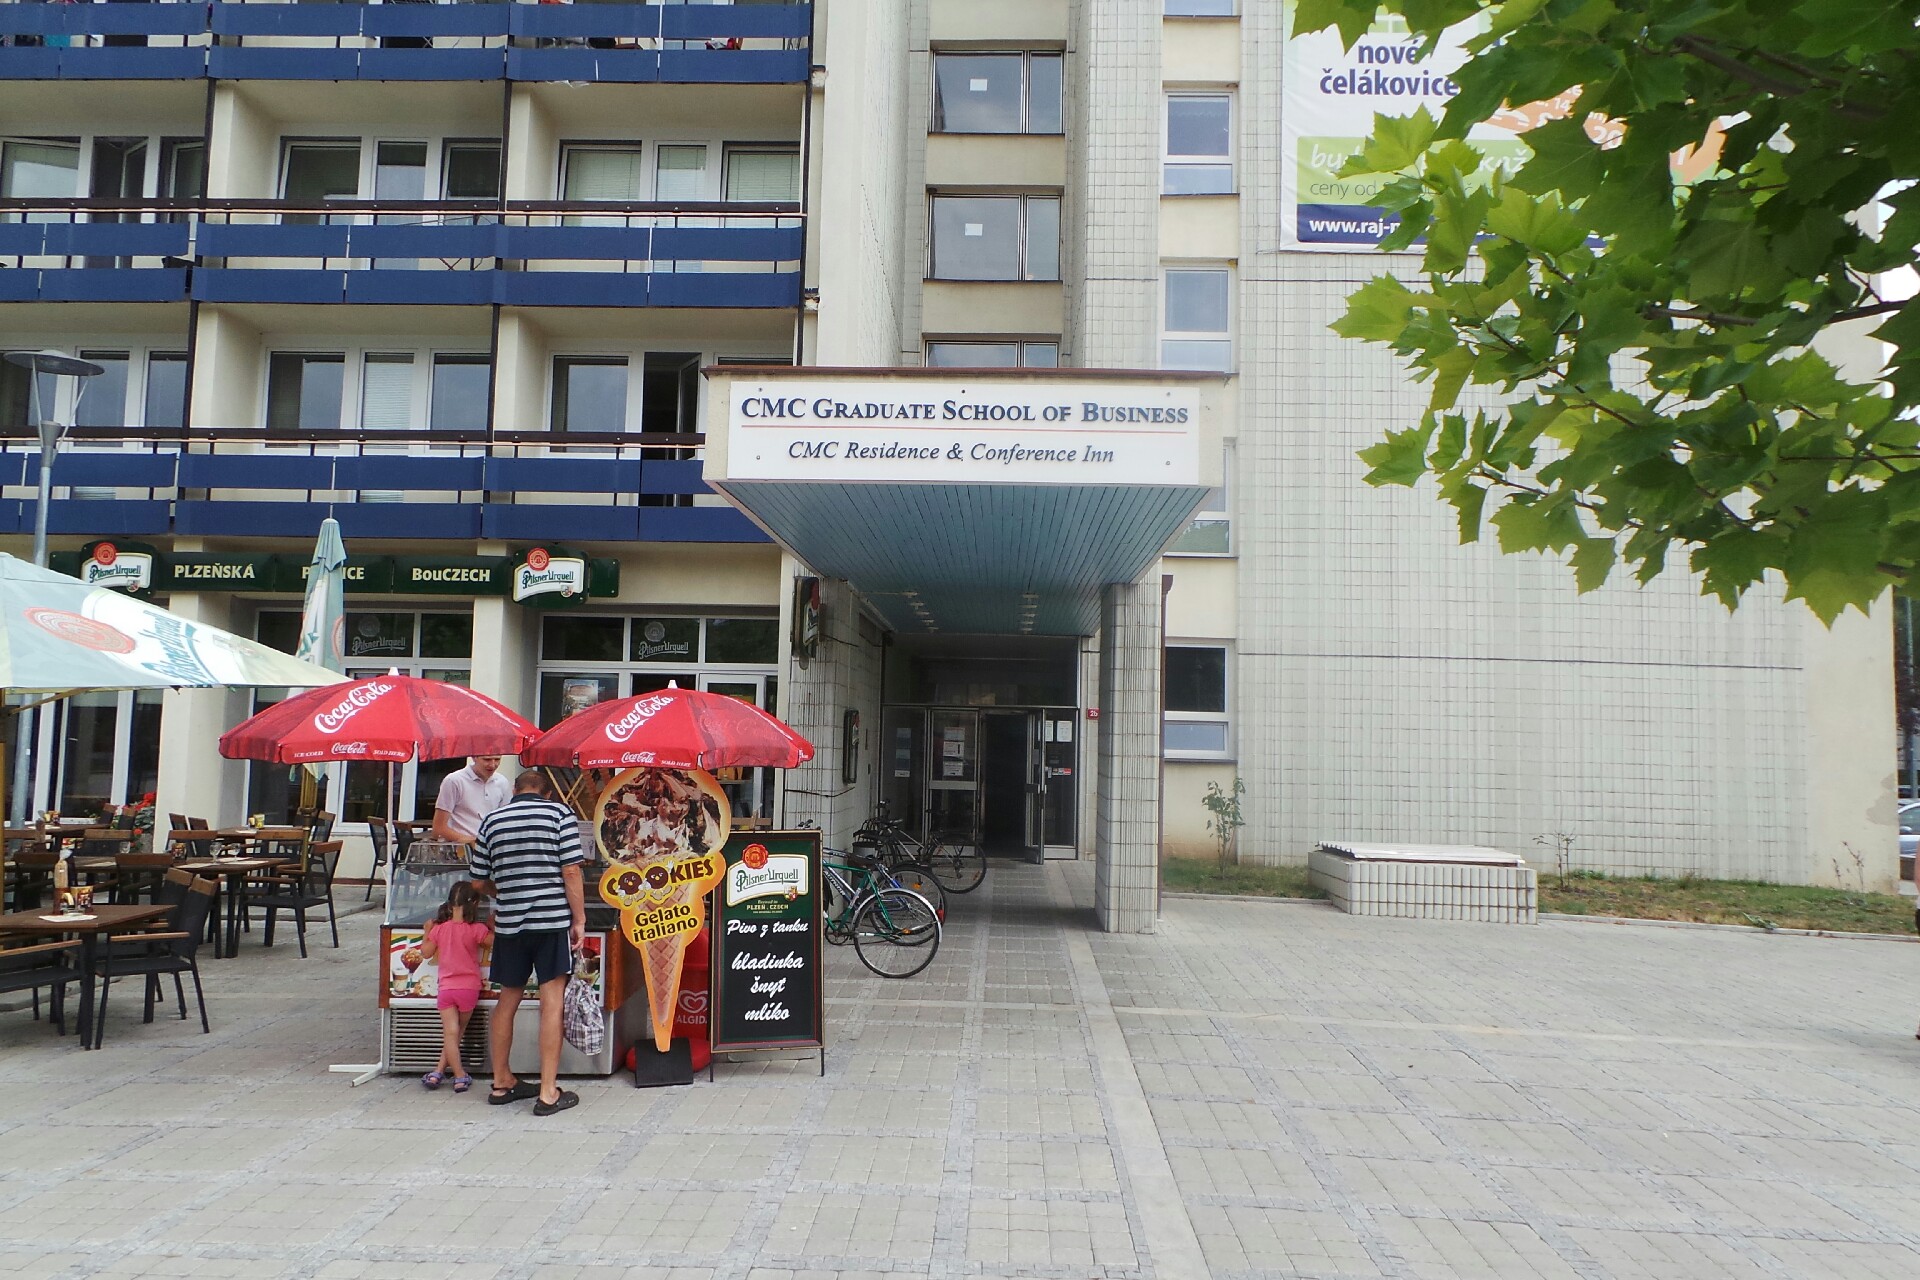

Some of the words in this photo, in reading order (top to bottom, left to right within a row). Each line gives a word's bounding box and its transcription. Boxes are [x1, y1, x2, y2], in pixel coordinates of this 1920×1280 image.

[1358, 40, 1419, 64] nové
[1320, 68, 1460, 97] čelákovice
[1310, 182, 1349, 201] ceny
[1355, 181, 1377, 197] od
[741, 397, 806, 419] CMC
[788, 441, 839, 460] CMC
[844, 441, 940, 461] Residence
[946, 443, 964, 462] &
[970, 445, 1078, 467] Conference
[1082, 445, 1114, 463] Inn
[89, 564, 115, 583] Pilsner
[115, 564, 142, 578] Urquell
[174, 562, 255, 579] PLZEŇSKÁ
[301, 566, 366, 580] PICE
[522, 570, 548, 589] Pilsner
[547, 569, 575, 585] Urquell
[352, 636, 380, 656] Pilsner
[379, 636, 406, 651] Urquell
[638, 640, 665, 659] Pilsner
[664, 641, 689, 656] Urquell
[314, 681, 396, 734] Coca-Cola
[605, 694, 678, 743] Coca-Cola
[331, 742, 368, 755] Coca-Cola
[621, 751, 656, 764] Coca-Cola
[735, 869, 769, 893] Pilsner
[768, 868, 799, 885] Urquell
[635, 904, 691, 927] Gelato
[633, 917, 698, 942] italiano
[727, 919, 757, 936] Pivo
[759, 924, 769, 938] z
[772, 918, 809, 933] tanku
[731, 950, 805, 970] hladinka
[750, 975, 787, 998] šnyt
[676, 1014, 707, 1024] ALGID
[744, 1001, 791, 1021] mlíko
